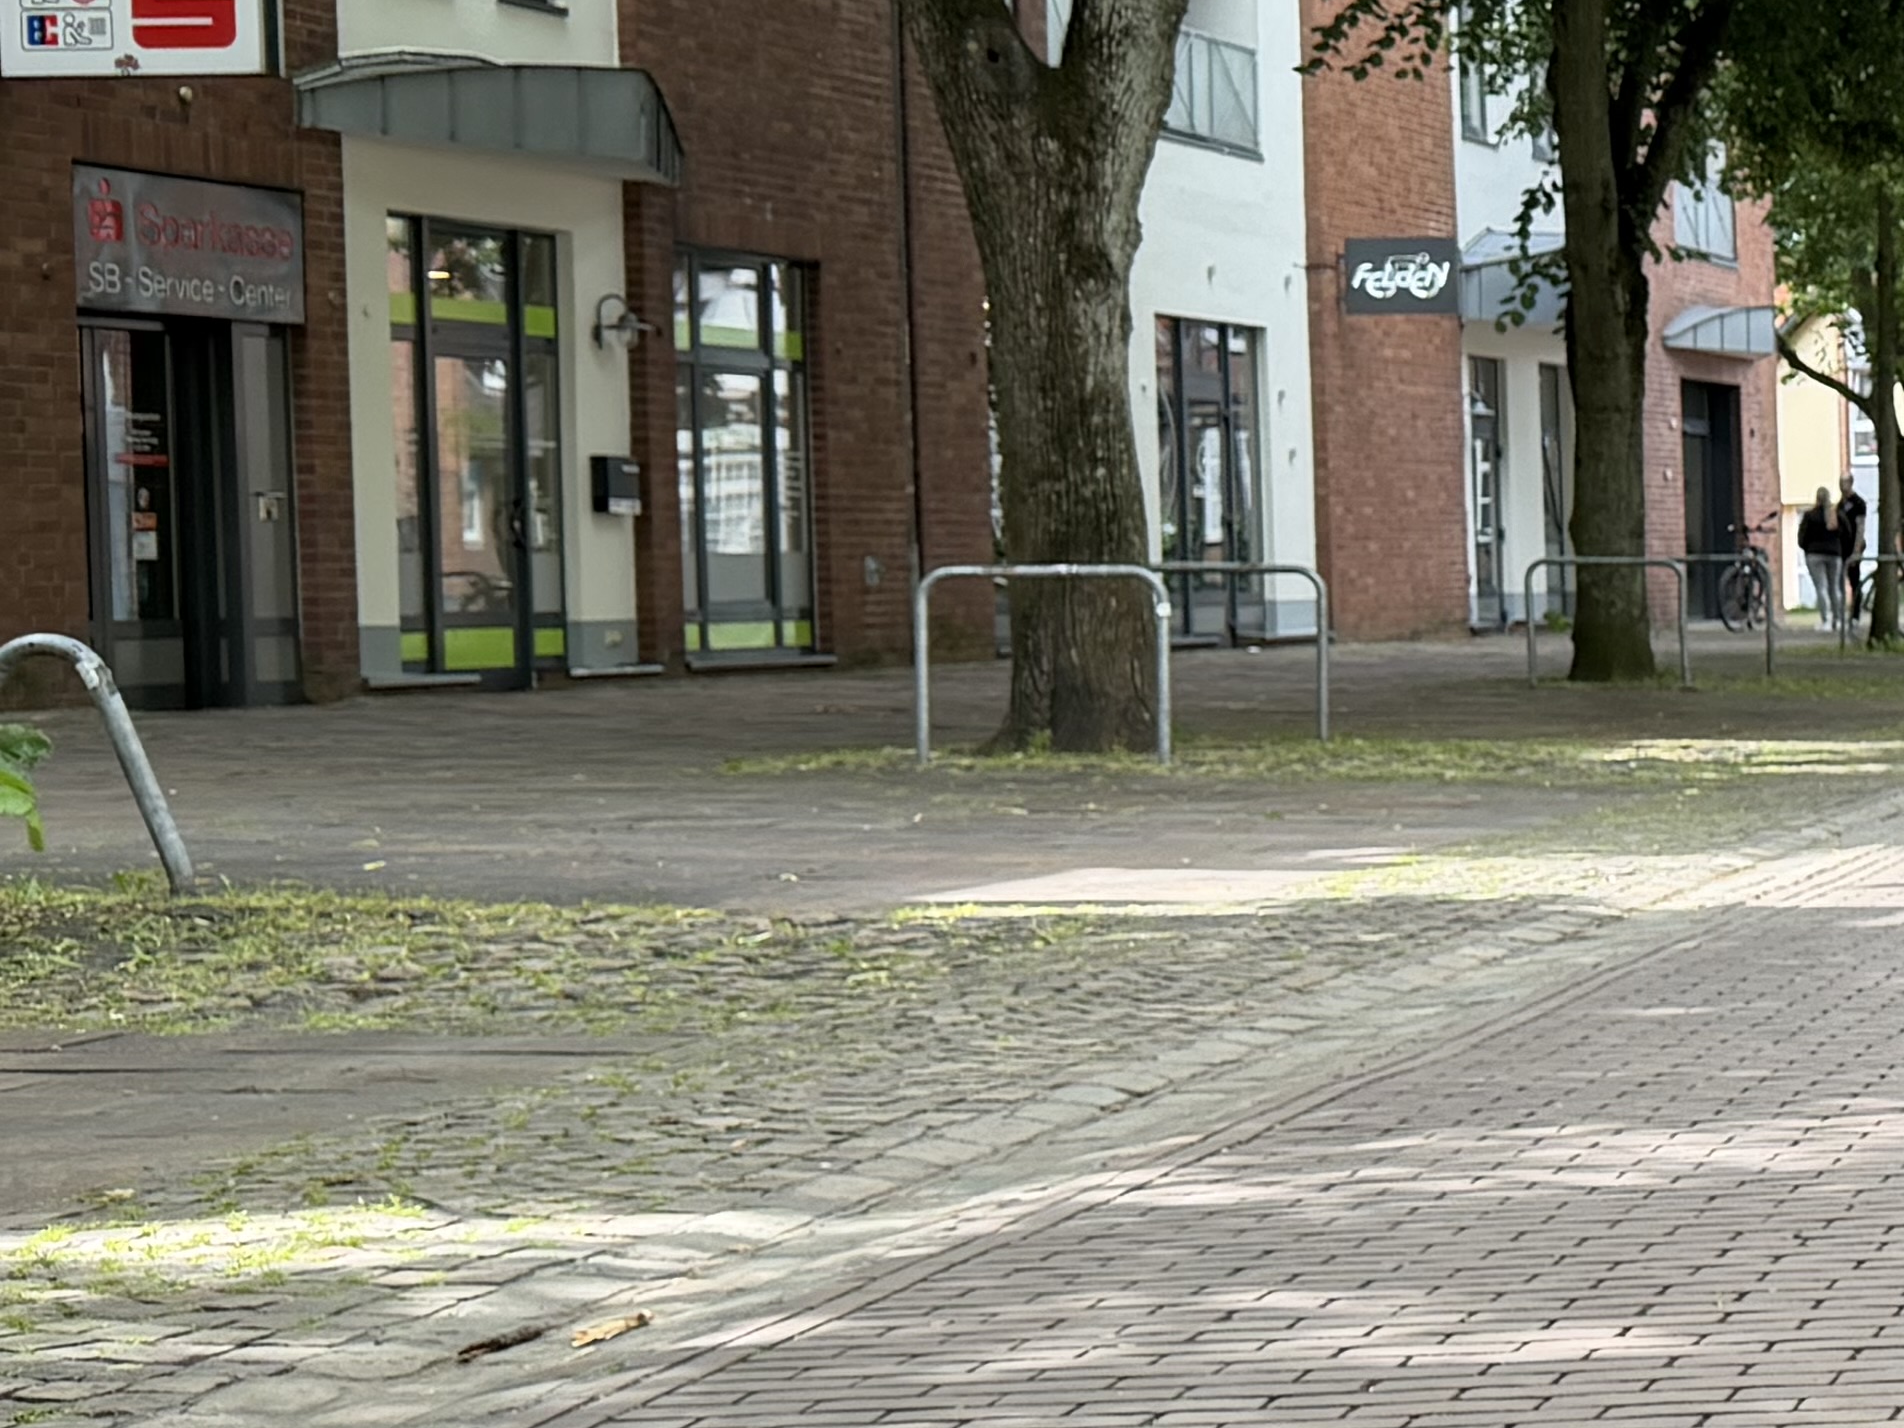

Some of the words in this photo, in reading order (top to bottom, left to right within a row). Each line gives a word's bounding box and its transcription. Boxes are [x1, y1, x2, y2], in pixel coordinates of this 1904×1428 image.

[138, 202, 294, 261] Sparkasse
[89, 261, 122, 294] SB
[138, 266, 215, 303] Service
[230, 275, 291, 309] Center
